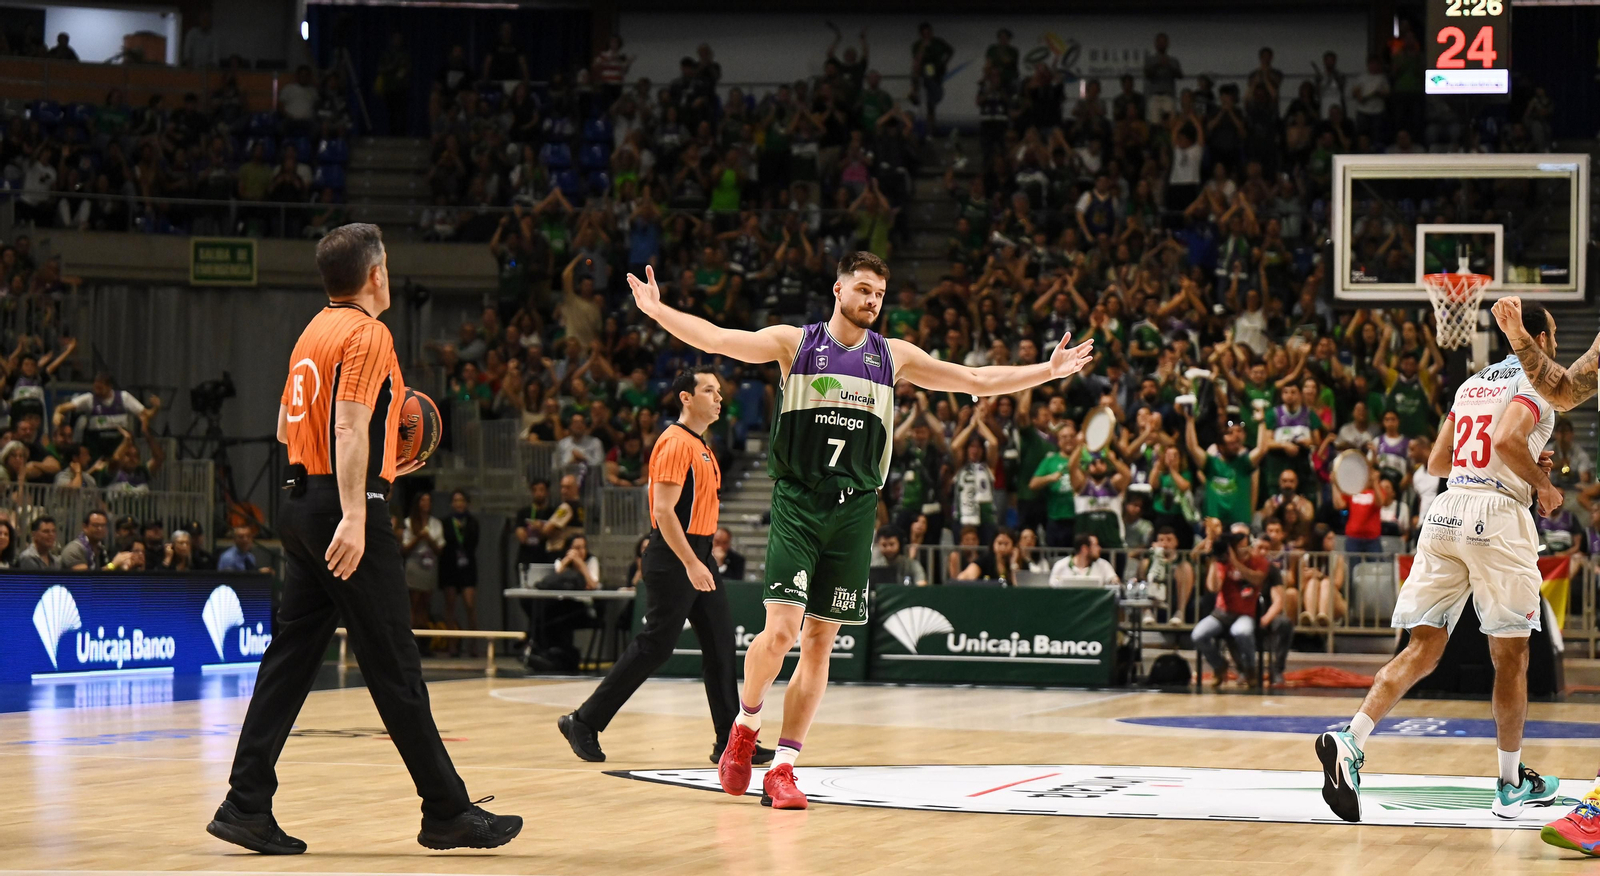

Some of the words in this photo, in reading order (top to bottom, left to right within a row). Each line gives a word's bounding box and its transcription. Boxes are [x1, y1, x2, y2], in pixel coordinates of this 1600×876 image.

[1445, 0, 1504, 17] 2:26
[1436, 25, 1498, 69] 24
[292, 374, 304, 407] 15
[840, 390, 876, 406] Unicaja
[815, 410, 865, 431] málaga
[402, 413, 420, 461] PALDING
[1453, 414, 1493, 468] 23
[827, 438, 846, 467] 7
[1432, 513, 1463, 526] Coruña
[831, 595, 856, 612] laga
[837, 589, 857, 602] má
[76, 625, 131, 669] Unicaja
[132, 628, 175, 660] Banco
[239, 621, 272, 656] Unic
[947, 630, 1032, 657] Unicaja
[1033, 634, 1103, 656] Banco
